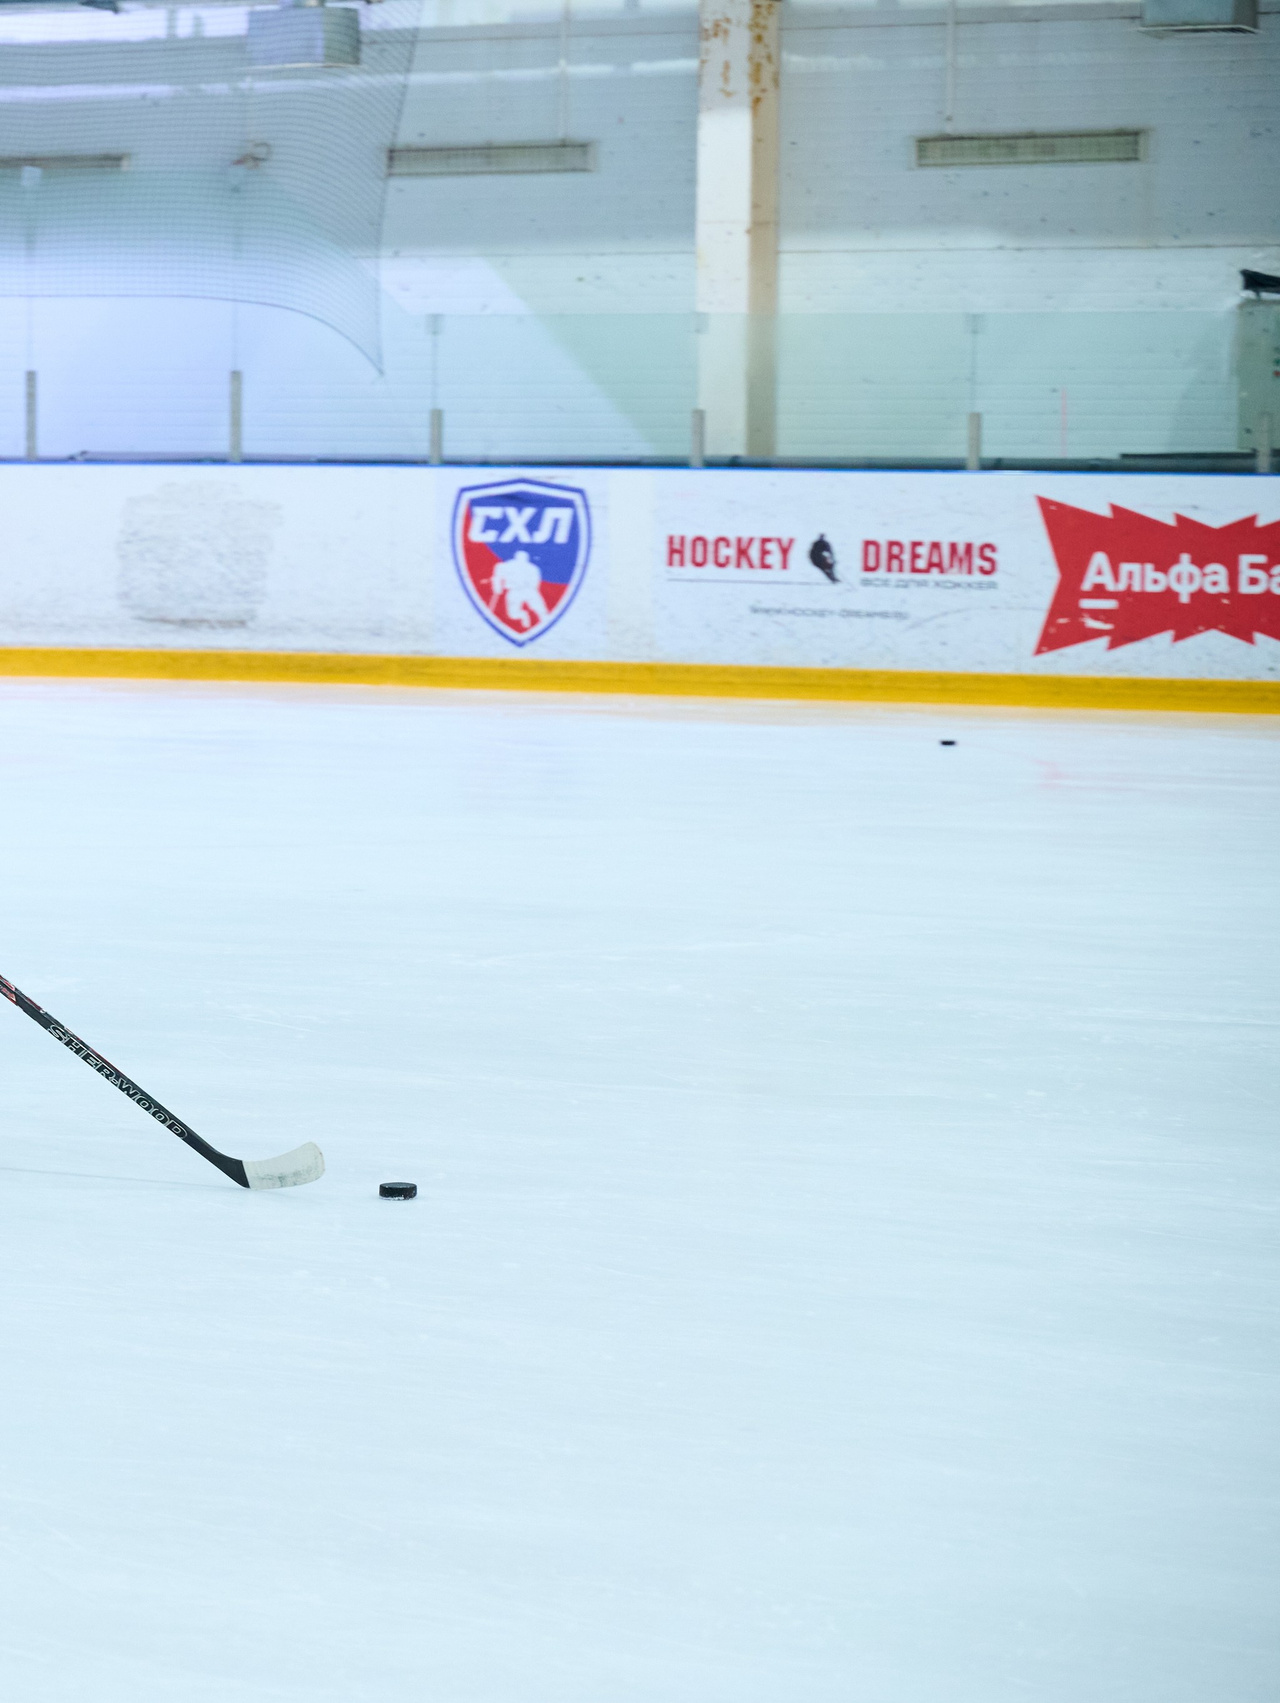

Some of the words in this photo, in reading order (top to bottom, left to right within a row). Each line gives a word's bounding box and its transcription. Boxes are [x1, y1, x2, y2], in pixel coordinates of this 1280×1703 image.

[468, 506, 574, 544] СХЛ
[666, 534, 796, 571] HOCKEY
[861, 539, 998, 575] DREAMS
[1080, 551, 1230, 604] Альфа
